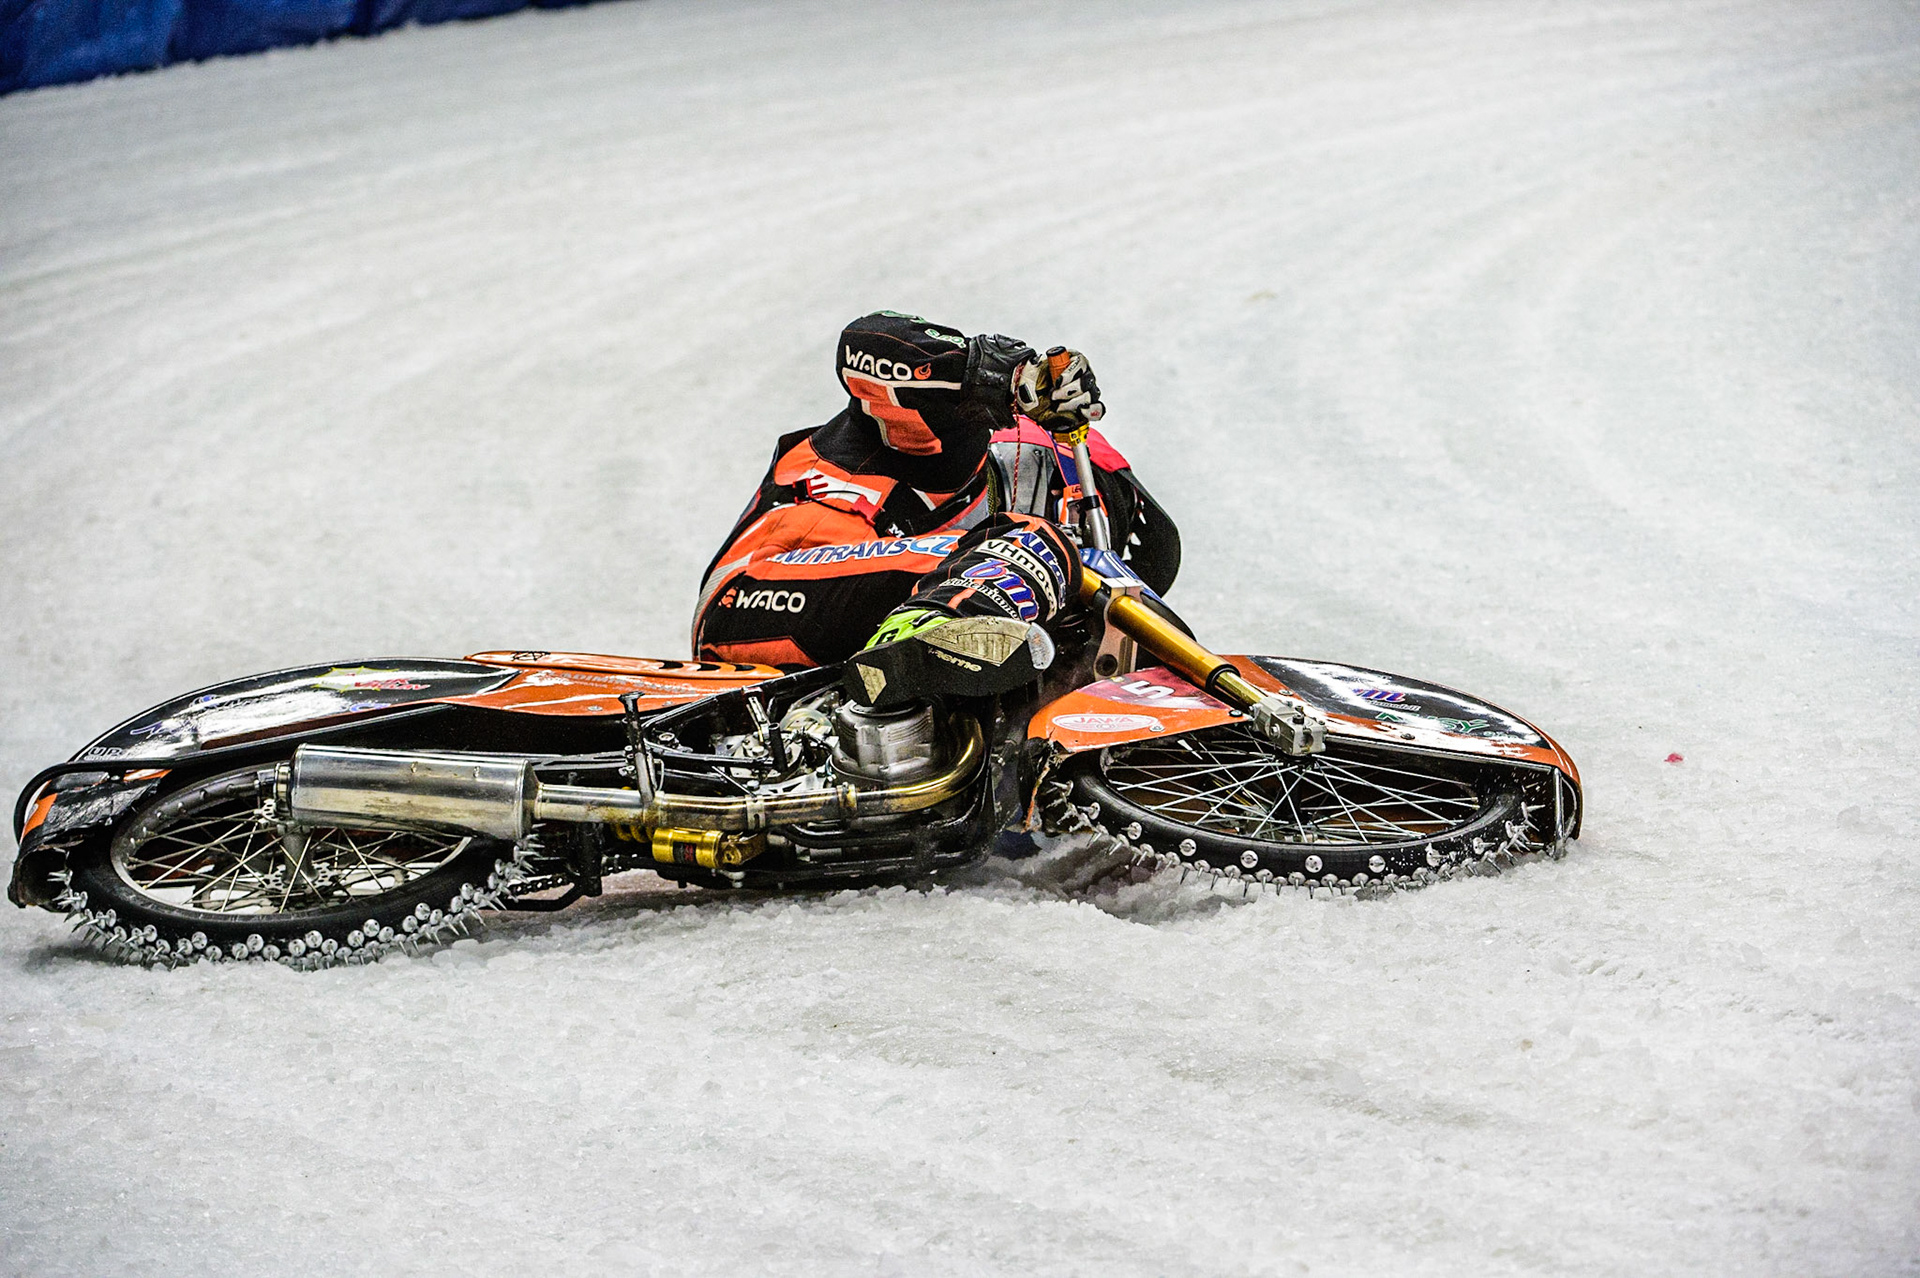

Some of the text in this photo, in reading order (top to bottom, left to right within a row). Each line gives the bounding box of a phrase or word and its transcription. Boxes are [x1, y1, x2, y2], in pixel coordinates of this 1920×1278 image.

[845, 344, 912, 381] WACO
[736, 589, 806, 613] WACO
[1120, 680, 1175, 699] 5
[1073, 716, 1134, 724] JAWA
